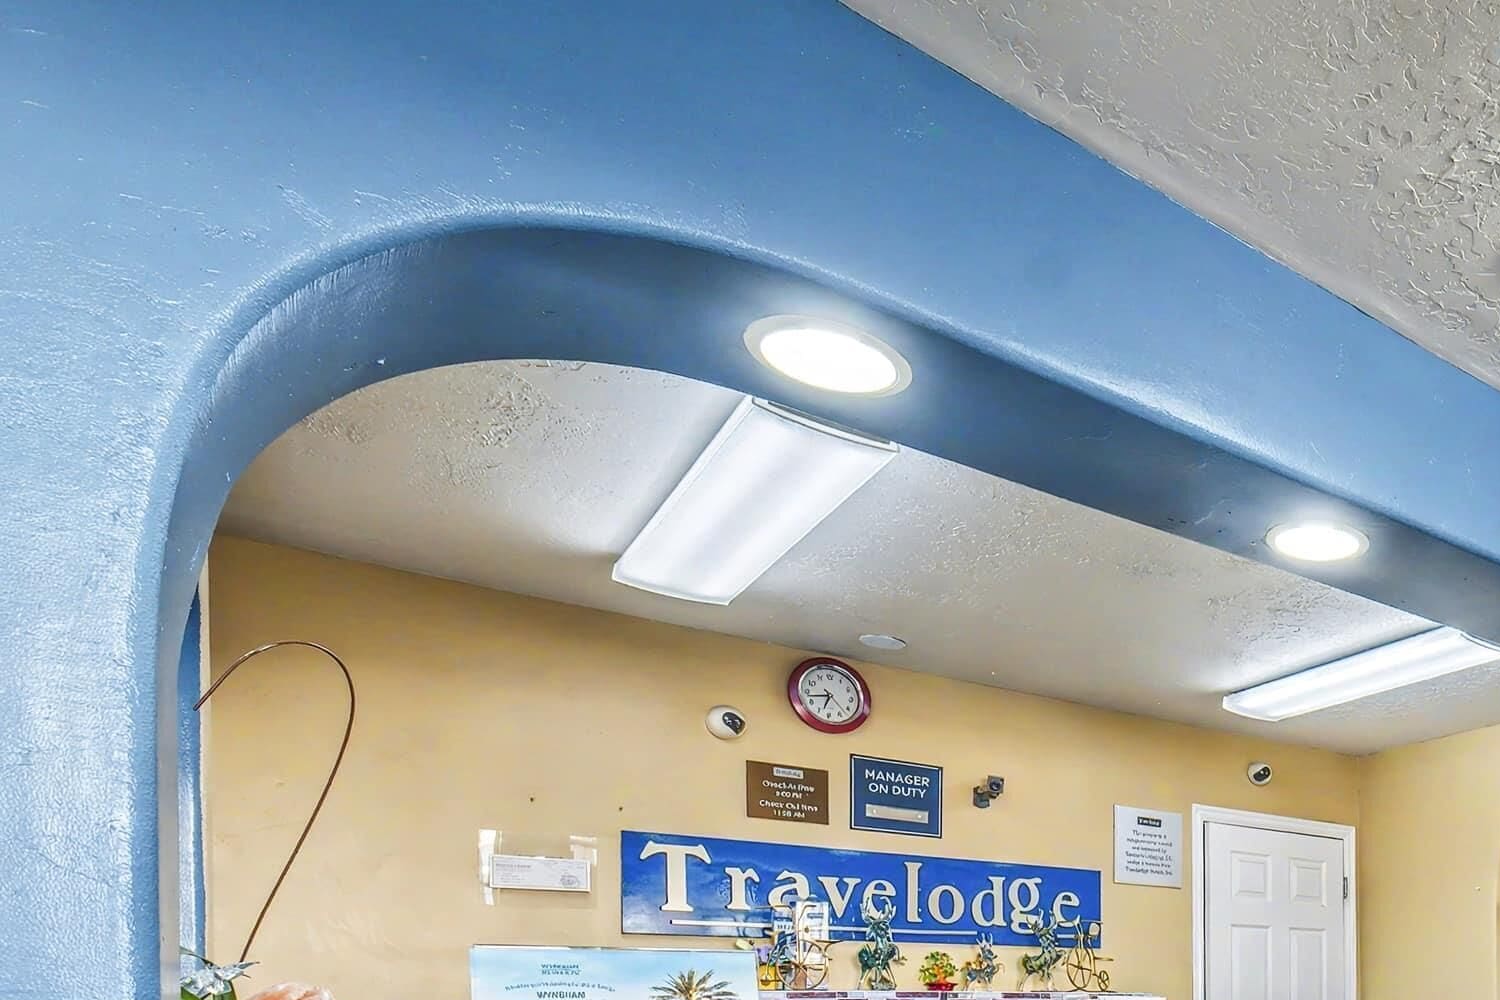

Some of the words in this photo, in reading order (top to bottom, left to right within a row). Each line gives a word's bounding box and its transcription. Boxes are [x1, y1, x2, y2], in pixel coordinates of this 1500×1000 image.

[864, 769, 930, 787] MANAGER
[869, 782, 890, 794] ON
[892, 785, 926, 799] DUTY
[640, 839, 1083, 935] Travelodge
